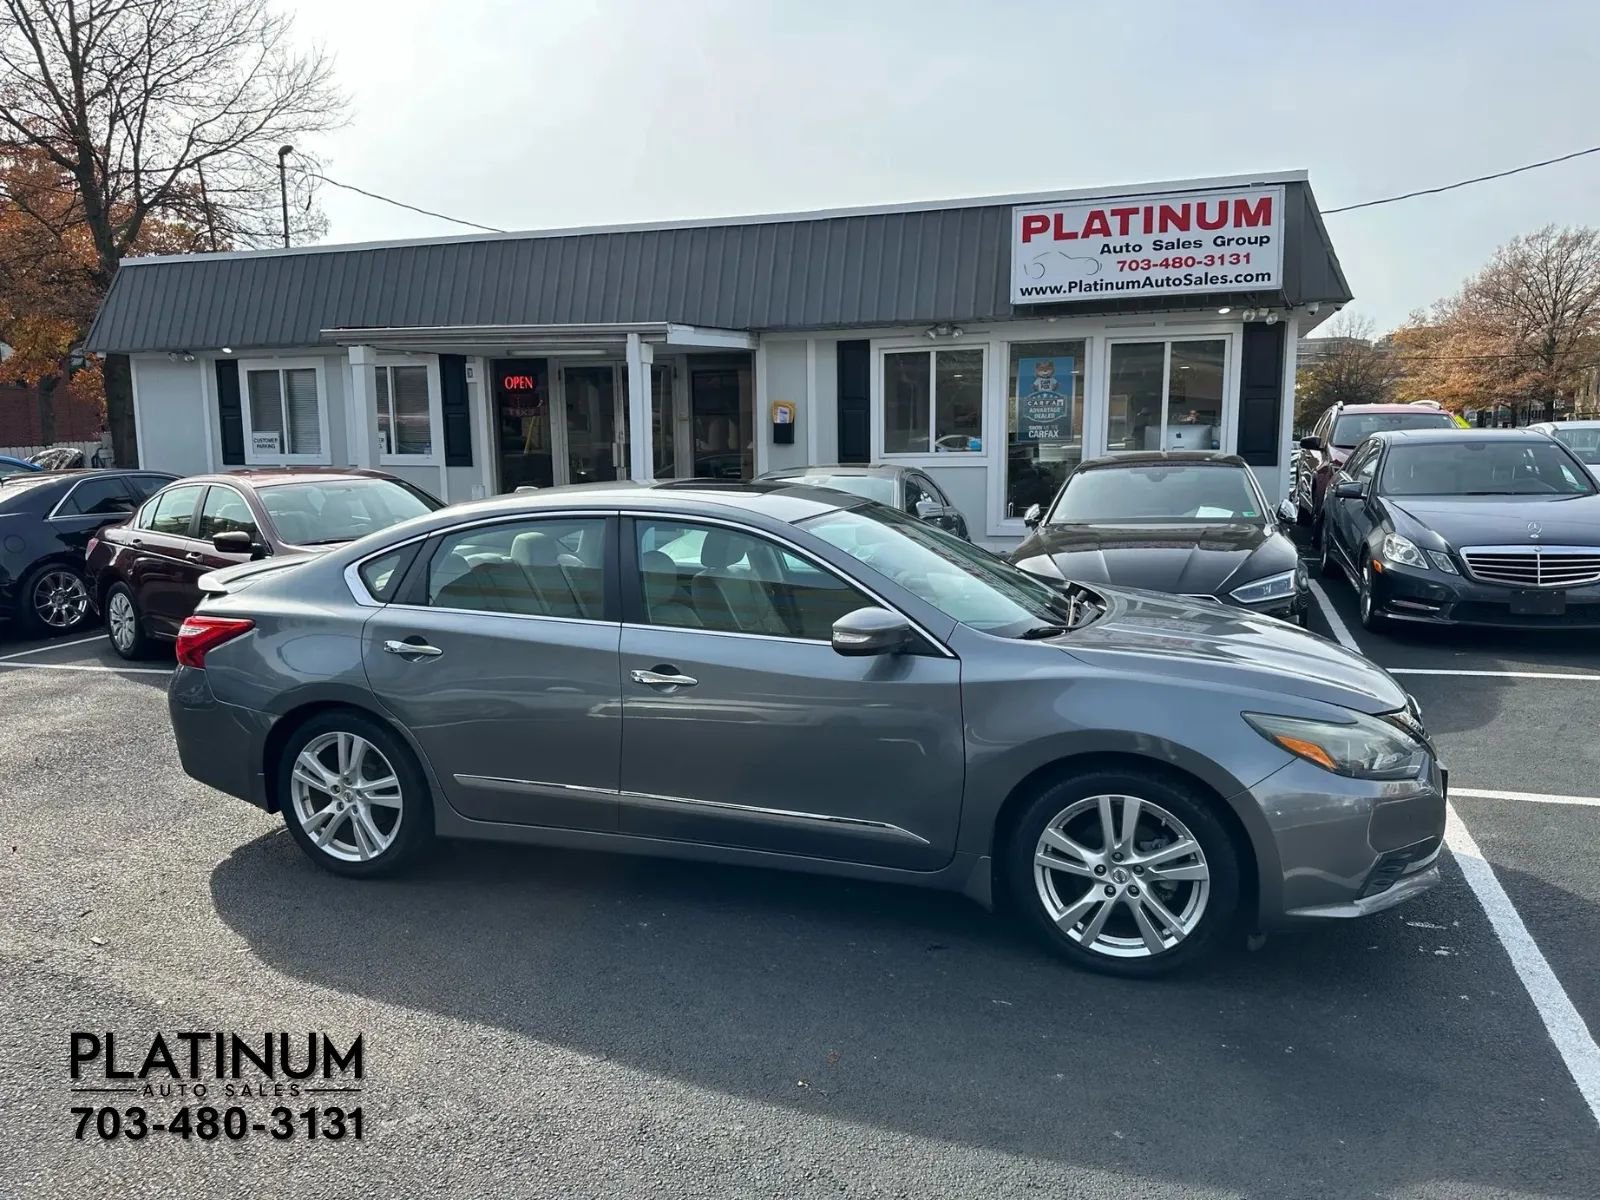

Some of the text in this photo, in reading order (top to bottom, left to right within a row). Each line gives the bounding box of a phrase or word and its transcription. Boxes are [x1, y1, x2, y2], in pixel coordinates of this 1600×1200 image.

[1021, 196, 1273, 244] PLATINUM
[1100, 233, 1271, 256] Auto Sales Group
[1117, 252, 1252, 272] 703-480-3131
[1019, 271, 1272, 297] www.PlatinumAutoSales.com
[504, 376, 533, 390] OPEN
[1028, 430, 1059, 438] CARFAX
